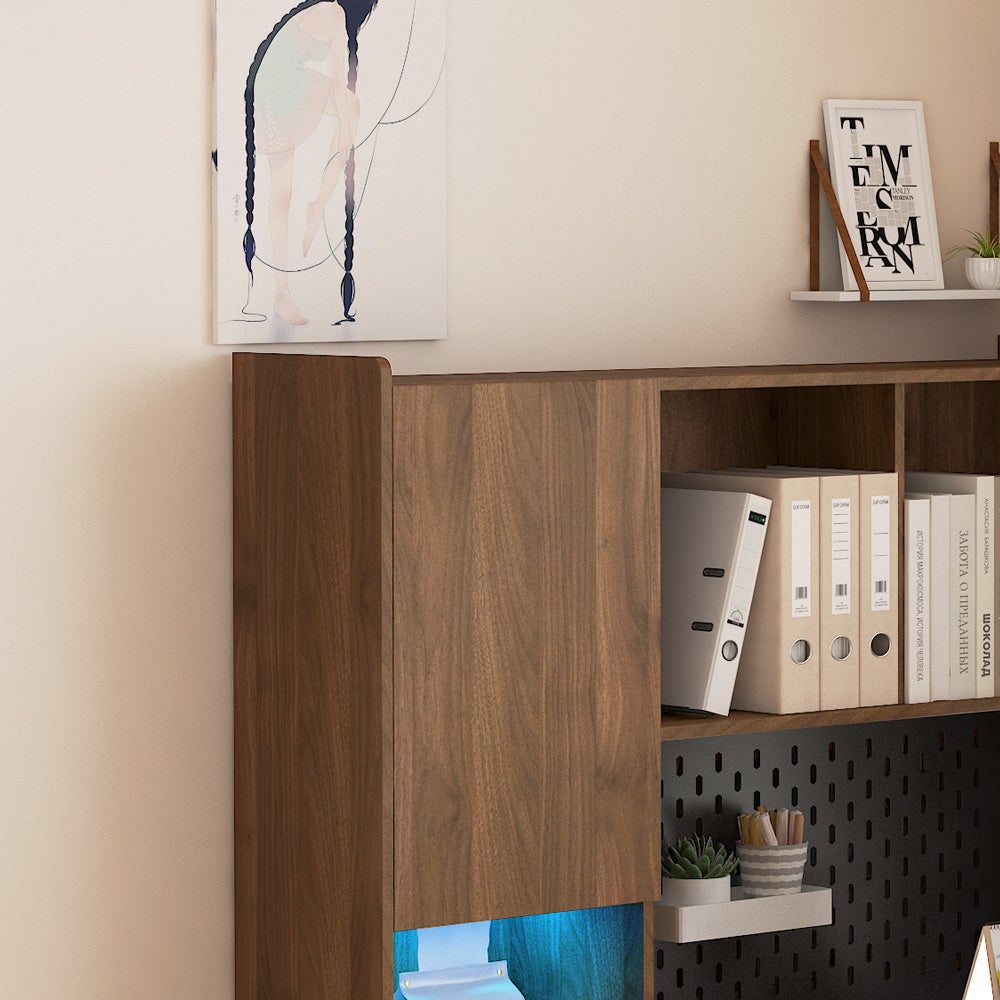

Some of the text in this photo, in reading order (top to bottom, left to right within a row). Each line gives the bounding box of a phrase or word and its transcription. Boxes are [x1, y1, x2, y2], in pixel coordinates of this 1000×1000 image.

[916, 530, 924, 560] ИСТОРИЯ
[957, 530, 969, 674] ЗАБОТА О ПРЕДАННЫХ
[916, 617, 924, 647] ИСТОРИЯ
[981, 613, 991, 677] ШОКОЛАД
[916, 648, 924, 682] ЧЕЛОВЕКА
